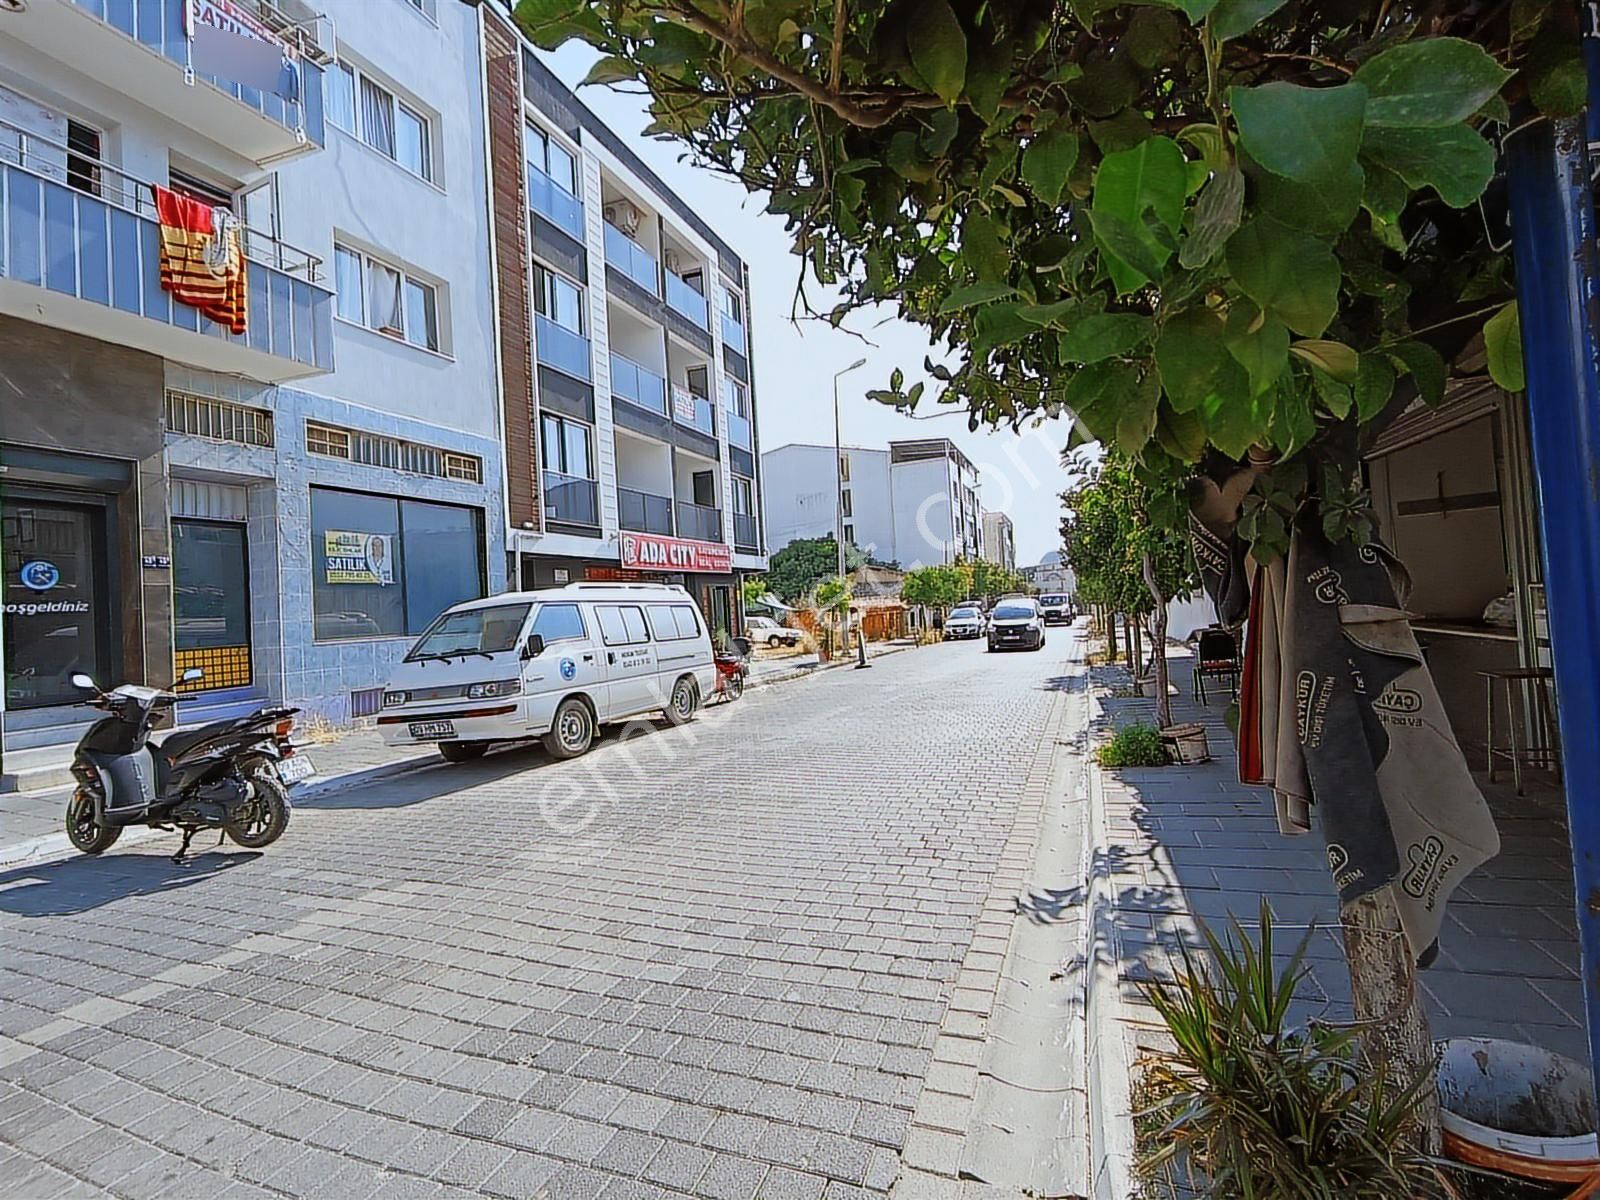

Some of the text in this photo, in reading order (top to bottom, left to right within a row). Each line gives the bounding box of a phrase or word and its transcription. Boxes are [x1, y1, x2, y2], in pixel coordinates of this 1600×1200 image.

[640, 541, 668, 564] ADA
[670, 543, 697, 566] CITY
[328, 557, 367, 570] SATILIK
